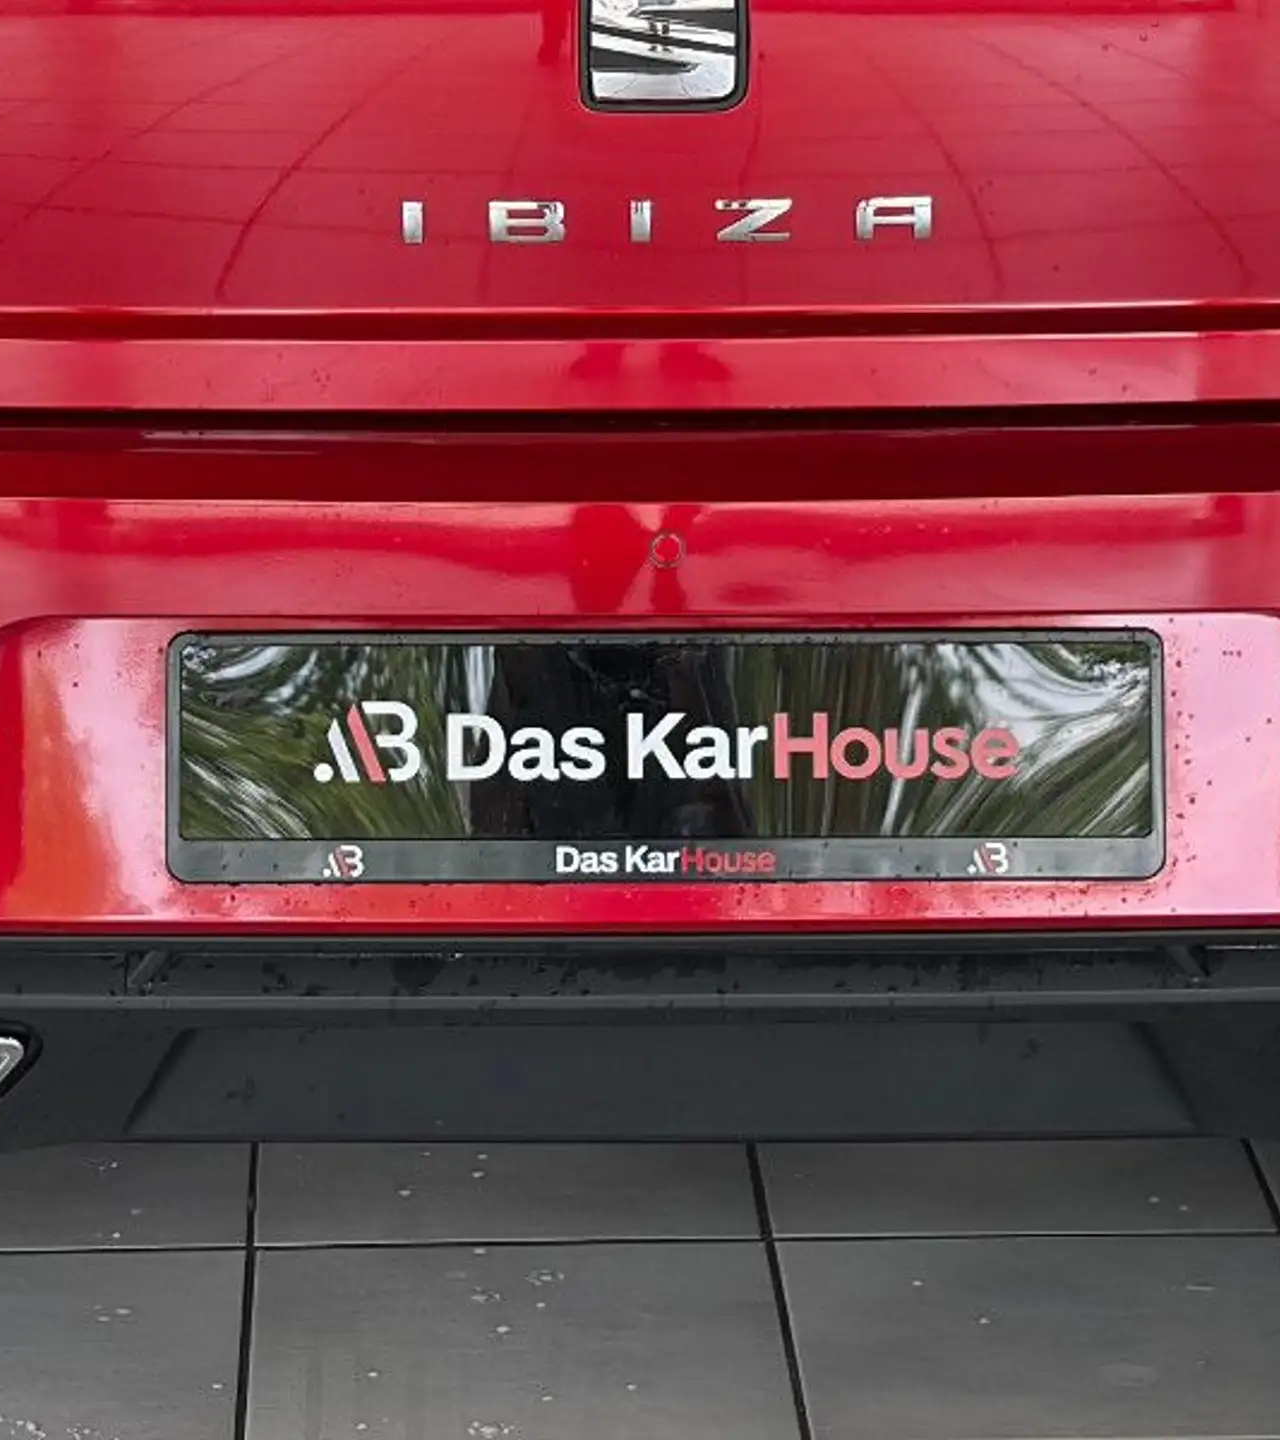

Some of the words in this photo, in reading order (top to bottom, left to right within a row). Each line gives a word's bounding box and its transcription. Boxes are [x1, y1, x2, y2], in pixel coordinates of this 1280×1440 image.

[402, 196, 933, 243] IBIZA
[446, 713, 608, 782] Das
[627, 711, 1020, 782] KarHouse
[556, 844, 618, 874] Das
[625, 844, 777, 876] KarHouse
